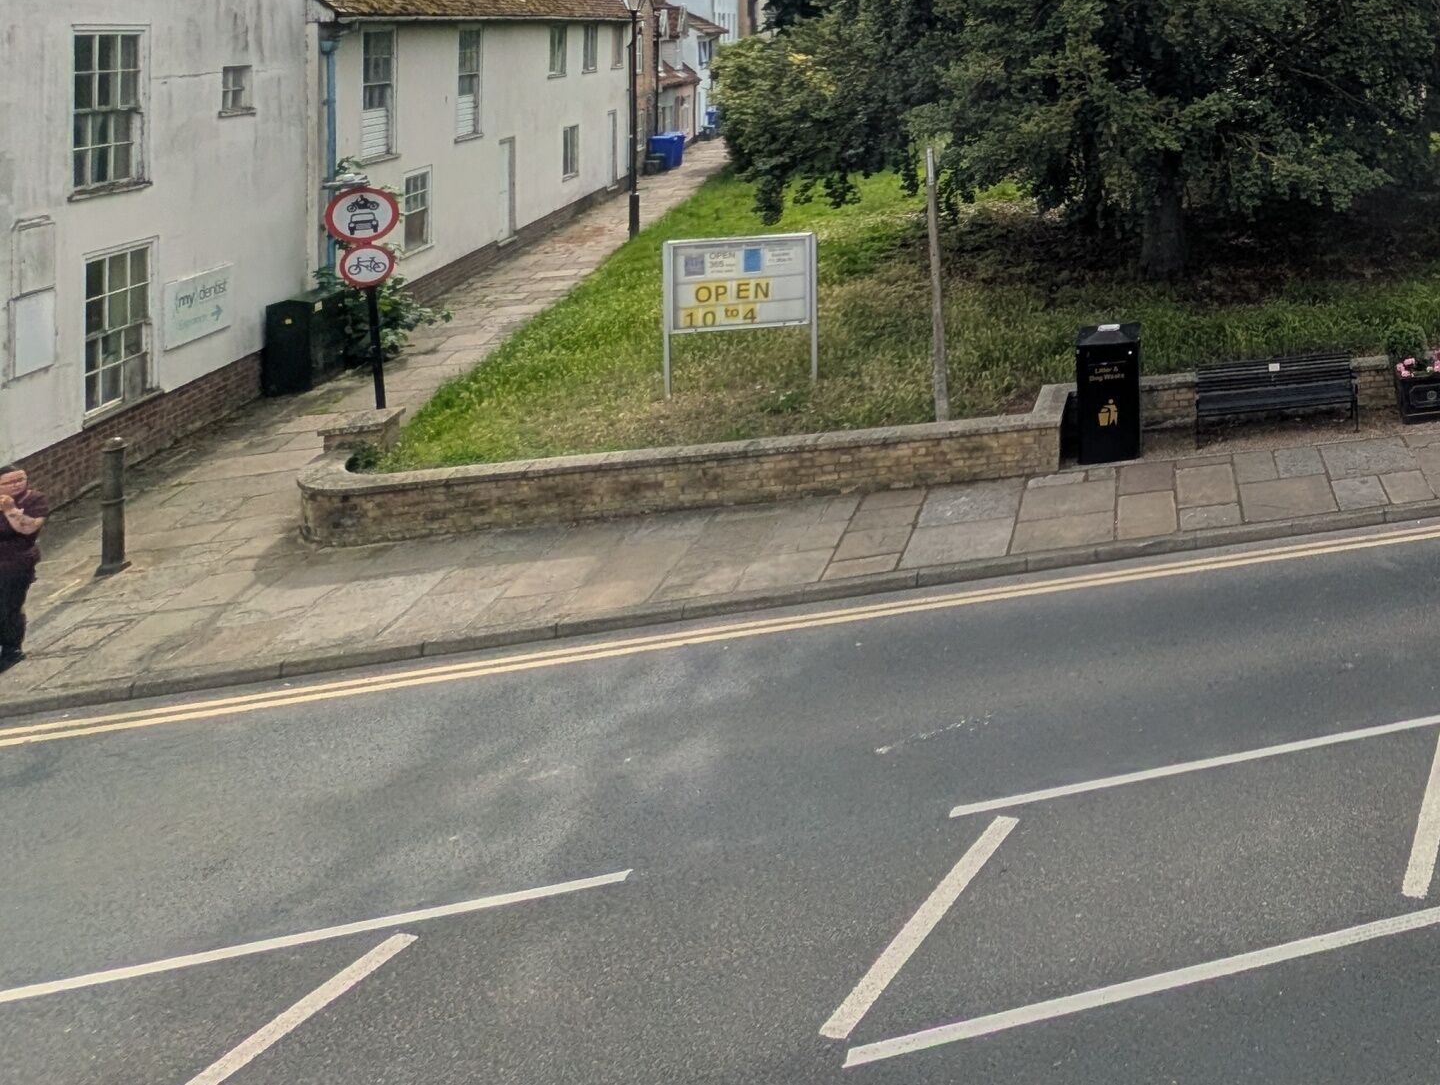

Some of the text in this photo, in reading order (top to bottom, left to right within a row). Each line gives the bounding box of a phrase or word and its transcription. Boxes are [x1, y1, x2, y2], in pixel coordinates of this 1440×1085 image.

[709, 252, 736, 261] OPEN
[199, 278, 229, 300] dentist
[695, 282, 769, 303] OPEN
[686, 307, 757, 326] 10 to 4
